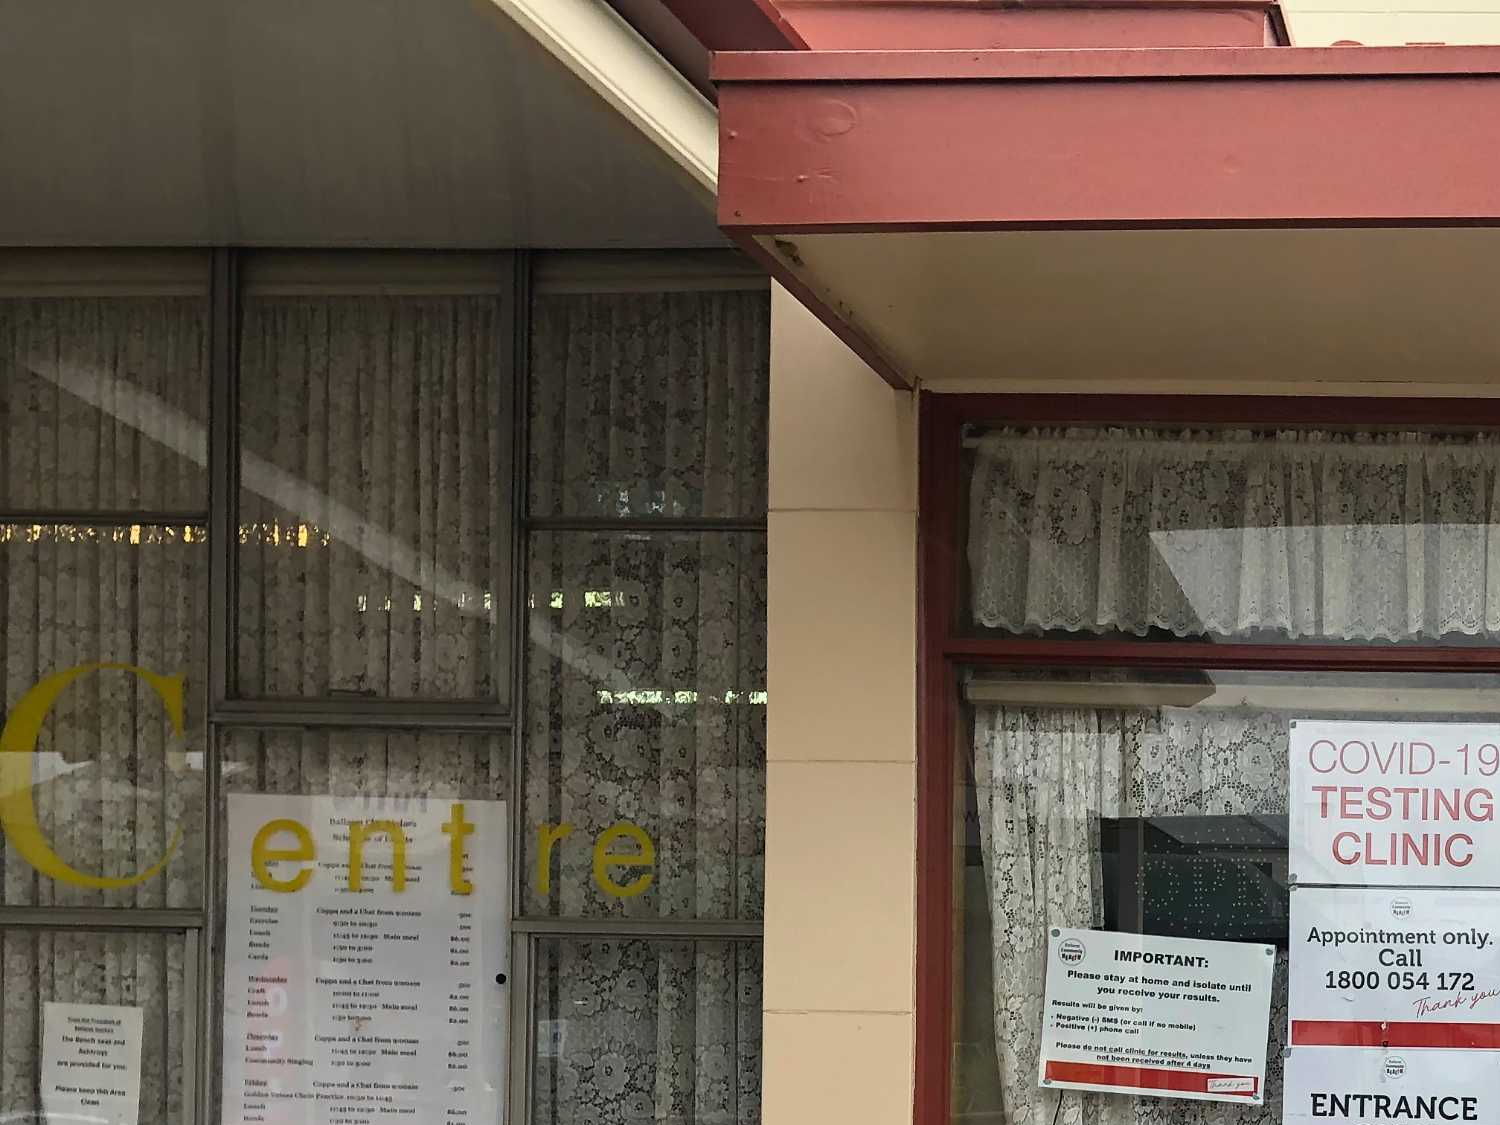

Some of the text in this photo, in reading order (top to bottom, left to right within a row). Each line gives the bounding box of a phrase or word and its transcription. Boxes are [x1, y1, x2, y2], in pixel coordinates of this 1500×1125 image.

[1309, 739, 1500, 776] COVID-19
[1311, 786, 1494, 821] TESTING
[1332, 831, 1473, 867] CLINIC
[1307, 927, 1494, 949] Appointment only.
[1114, 950, 1209, 968] IMPORTANT:
[1378, 948, 1423, 967] Call
[1067, 970, 1252, 992] Please stay at home and isolate until
[1325, 970, 1475, 991] 1800 054 172
[1052, 1000, 1080, 1008] Results
[1108, 1004, 1129, 1012] given
[1097, 987, 1220, 1003] you receive your results.
[1412, 991, 1468, 1019] Thank
[1310, 1093, 1478, 1121] ENTRANCE
